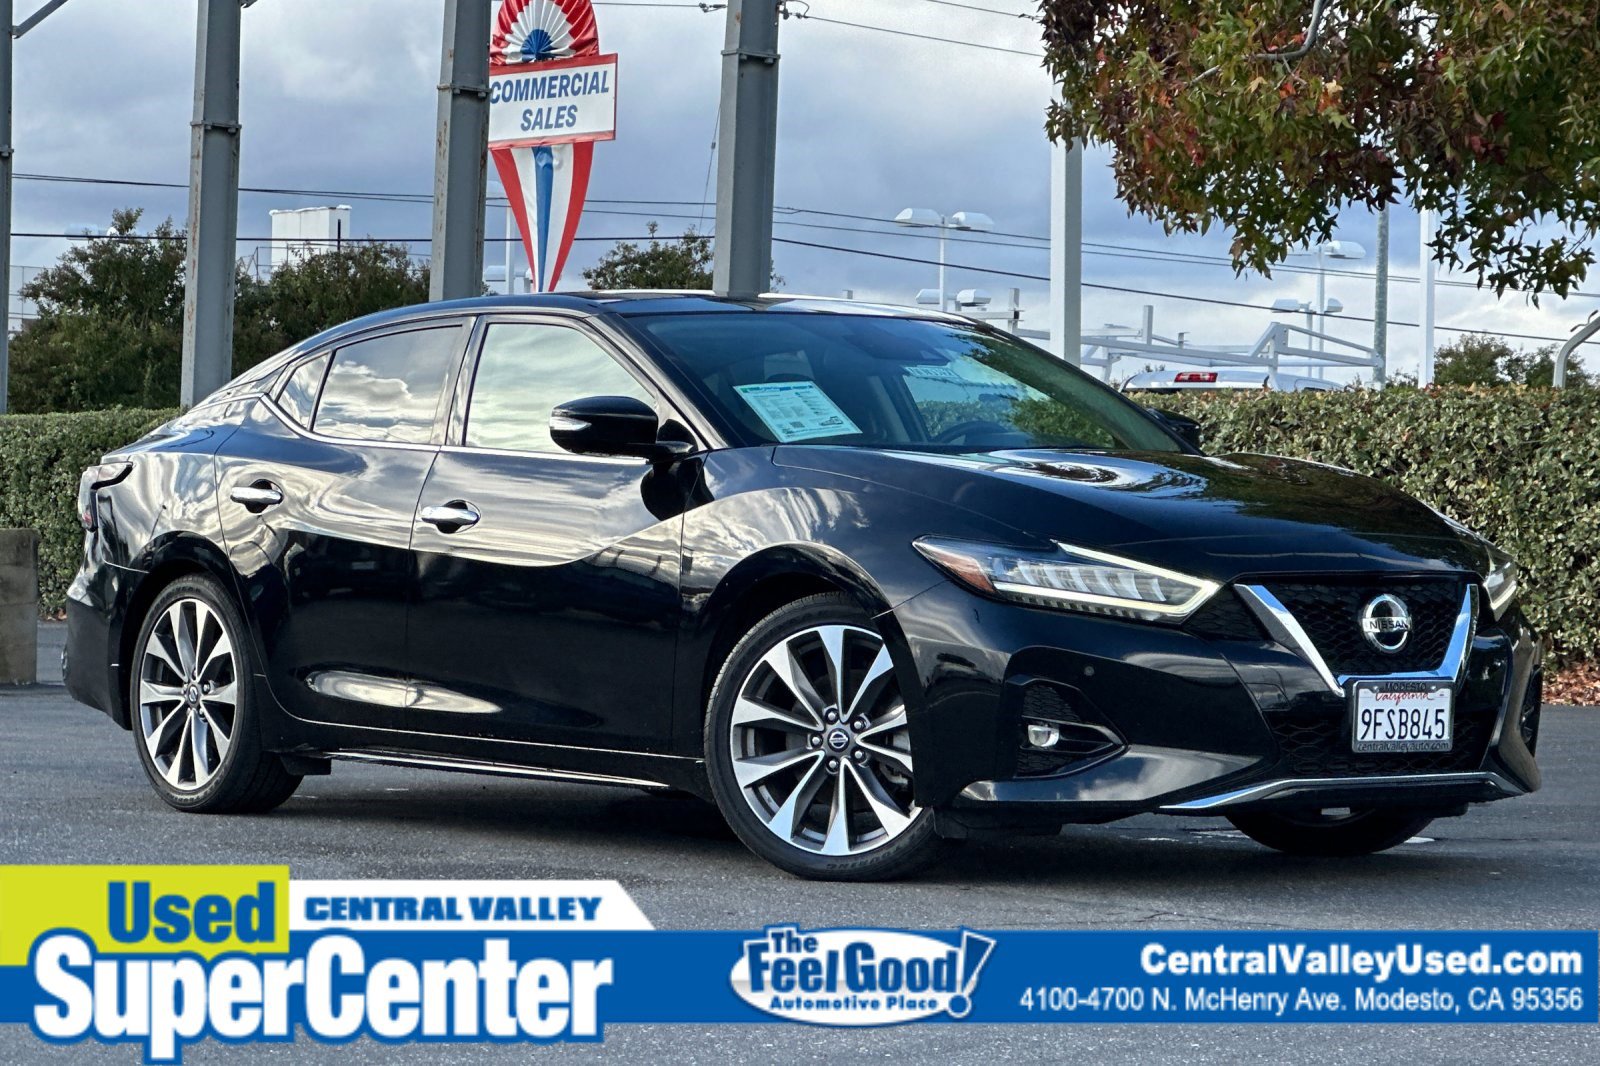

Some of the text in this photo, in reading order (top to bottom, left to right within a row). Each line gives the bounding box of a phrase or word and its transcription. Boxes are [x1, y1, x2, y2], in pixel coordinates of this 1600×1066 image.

[490, 71, 609, 104] COMMERCIAL
[521, 105, 578, 131] SALES
[1369, 619, 1408, 629] NISSAN
[1385, 682, 1427, 691] MODESTO
[1360, 708, 1445, 740] 9FSB845
[1357, 740, 1449, 753] centralvalleyauto.com
